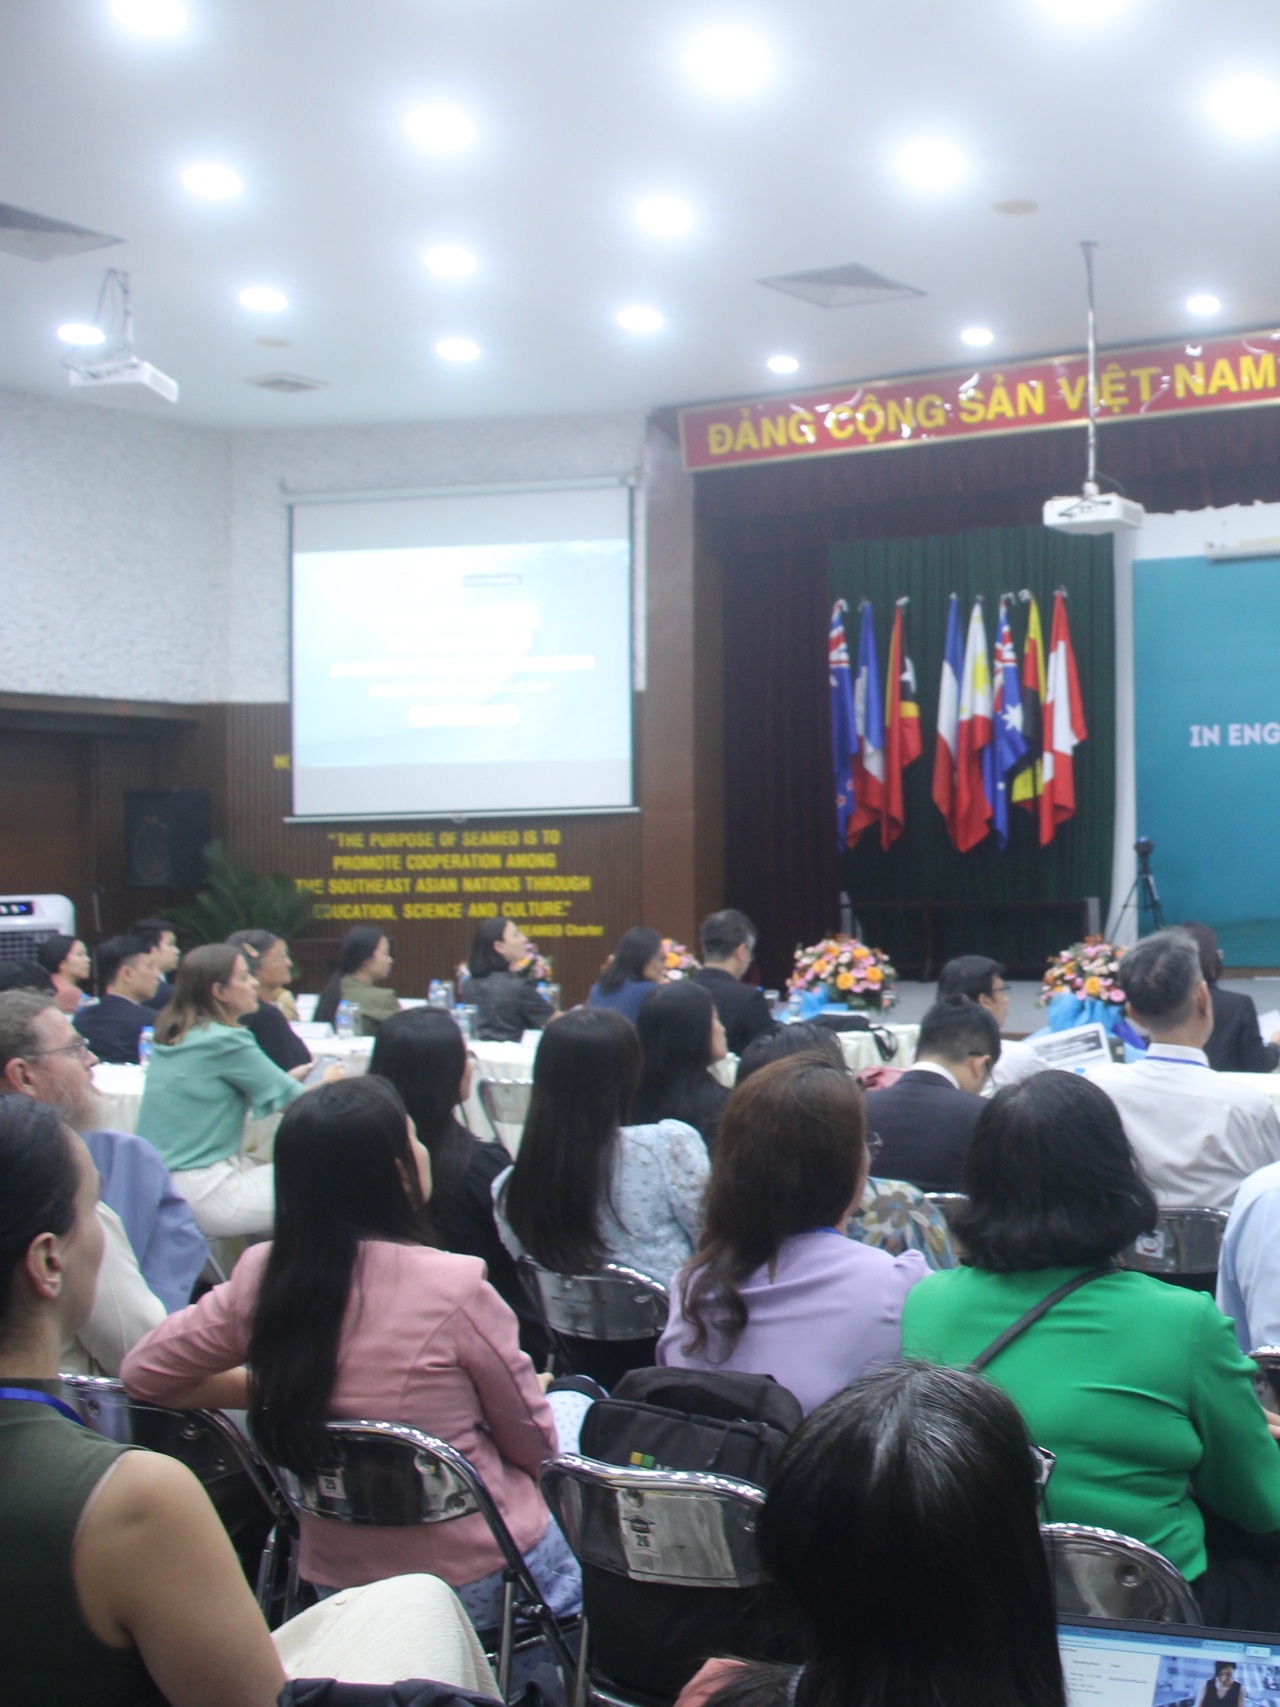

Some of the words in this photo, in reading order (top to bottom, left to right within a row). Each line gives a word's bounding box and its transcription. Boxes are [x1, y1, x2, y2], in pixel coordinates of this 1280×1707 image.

[707, 406, 814, 455] ĐẢNG
[826, 391, 947, 445] CỘNG
[957, 373, 1045, 424] SẢN
[1056, 363, 1157, 415] VIỆT
[1173, 352, 1276, 398] NAM
[1189, 724, 1220, 748] IN
[369, 831, 435, 848] PURPOSE
[439, 831, 457, 847] OF
[462, 830, 520, 847] SEAMEO
[523, 829, 538, 846] IS
[541, 829, 561, 846] TO
[332, 855, 402, 871] PROMOTE
[405, 853, 502, 870] COOPERATION
[505, 852, 558, 869] AMONG
[327, 877, 412, 895] SOUTHEAST
[415, 877, 458, 893] ASIAN
[461, 876, 521, 893] NATIONS
[525, 875, 592, 892] THROUGH
[402, 902, 462, 919] SCIENCE
[467, 901, 498, 918] AND
